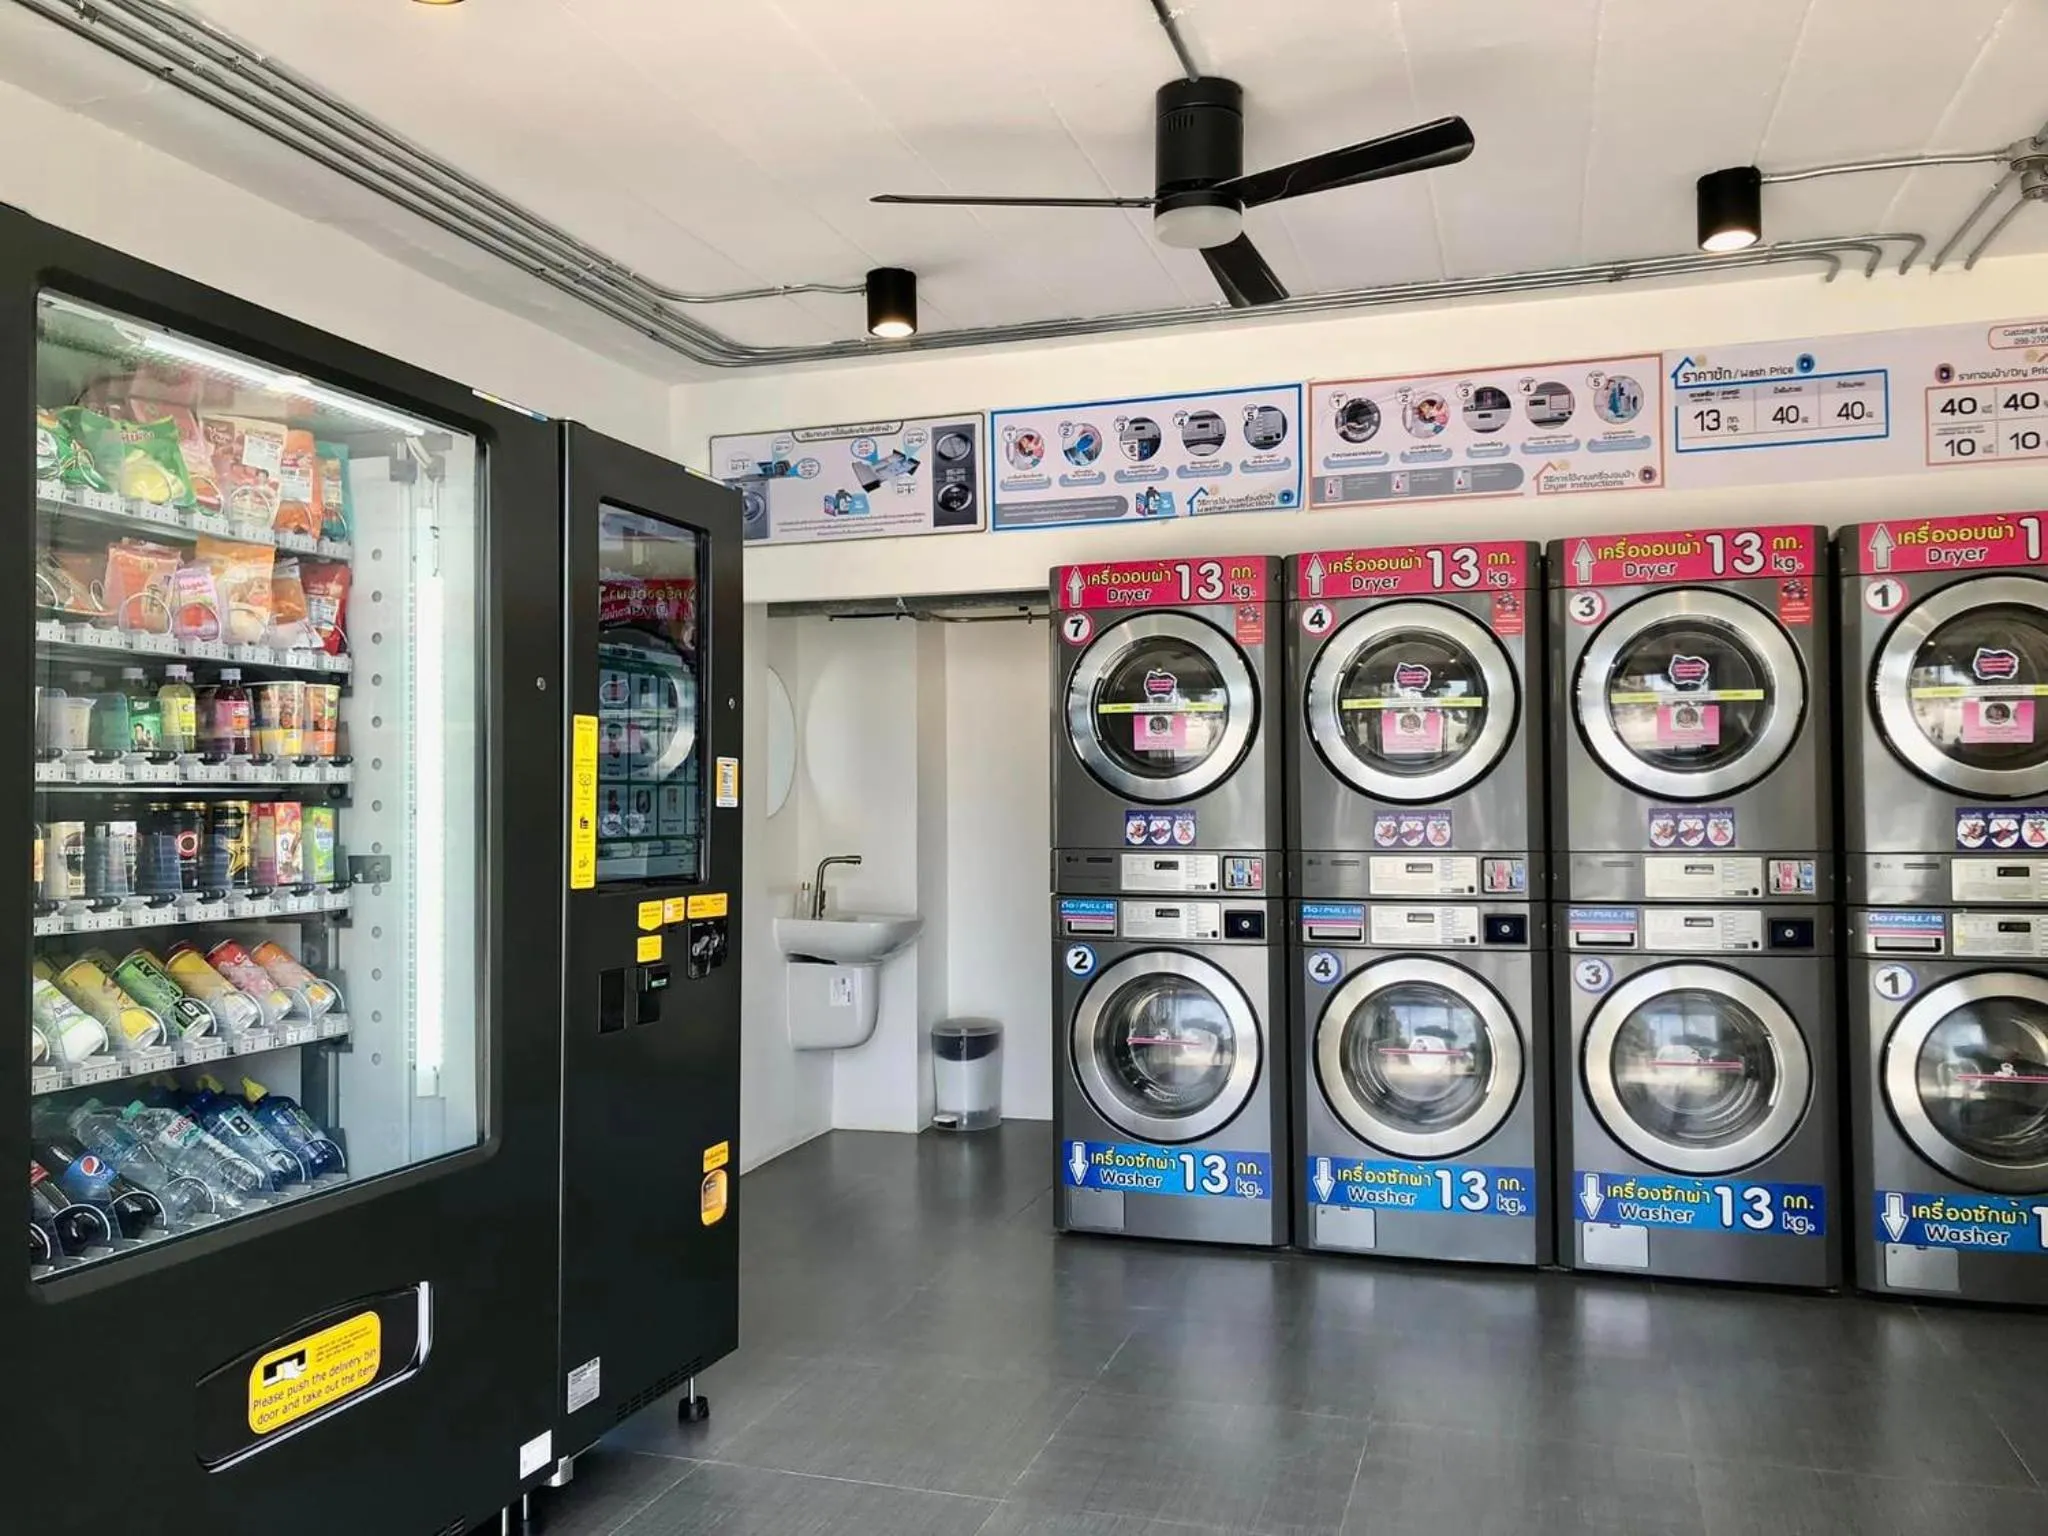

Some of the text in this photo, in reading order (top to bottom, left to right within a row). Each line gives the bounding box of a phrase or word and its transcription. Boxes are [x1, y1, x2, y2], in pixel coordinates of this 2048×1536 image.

[1770, 365, 1794, 377] Price
[1402, 394, 1408, 402] 2
[1462, 389, 1468, 397] 3
[1524, 384, 1531, 392] 4
[1594, 378, 1600, 387] 5
[1940, 397, 1978, 416] 40
[2004, 392, 2040, 412] 40
[1063, 428, 1070, 436] 2
[1119, 422, 1125, 430] 3
[1178, 418, 1184, 426] 4
[1248, 412, 1254, 420] 5
[1694, 408, 1721, 432] 13
[1772, 405, 1800, 424] 40
[1836, 401, 1865, 420] 40
[1944, 438, 1976, 456] 10
[2010, 432, 2041, 450] 10
[1544, 482, 1568, 492] Dryer
[1897, 516, 2042, 561] เครื่องอบผ้า 1
[1598, 531, 1803, 576] เครื่องอบผ้า 13 กก.
[1927, 546, 1988, 566] Dryer
[1328, 546, 1516, 588] เครื่องอบผ้า 13 กก.
[1624, 561, 1677, 580] Dryer
[1087, 560, 1257, 602] เครื่องอบผ้า 13 กก.
[1352, 575, 1400, 593] Dryer
[1108, 587, 1151, 604] Dryer
[1578, 596, 1596, 617] 3
[1873, 584, 1889, 607] 1
[1069, 618, 1084, 638] 7
[1308, 609, 1326, 628] 4
[1072, 950, 1088, 970] 2
[1314, 957, 1334, 977] 4
[1585, 964, 1602, 985] 3
[1884, 972, 1900, 994] 1
[1090, 1147, 1263, 1194] เครื่องซักผ้า 13 กก.
[1100, 1170, 1162, 1189] Washer
[1337, 1162, 1526, 1212] เครื่องซักผ้า 13 กก.
[1348, 1186, 1416, 1206] Washer
[1606, 1178, 1814, 1230] เครื่องซักผ้า 13 กก.
[1618, 1203, 1694, 1224] Washer
[1912, 1197, 2028, 1224] เครื่องซักผ้า
[1925, 1224, 2009, 1246] Washer
[253, 1390, 286, 1410] Please
[287, 1378, 310, 1400] push
[311, 1370, 327, 1386] the
[328, 1356, 362, 1380] delivery
[256, 1408, 280, 1425] door
[282, 1397, 300, 1414] and
[302, 1388, 322, 1406] take
[324, 1382, 340, 1396] out
[342, 1372, 356, 1388] the
